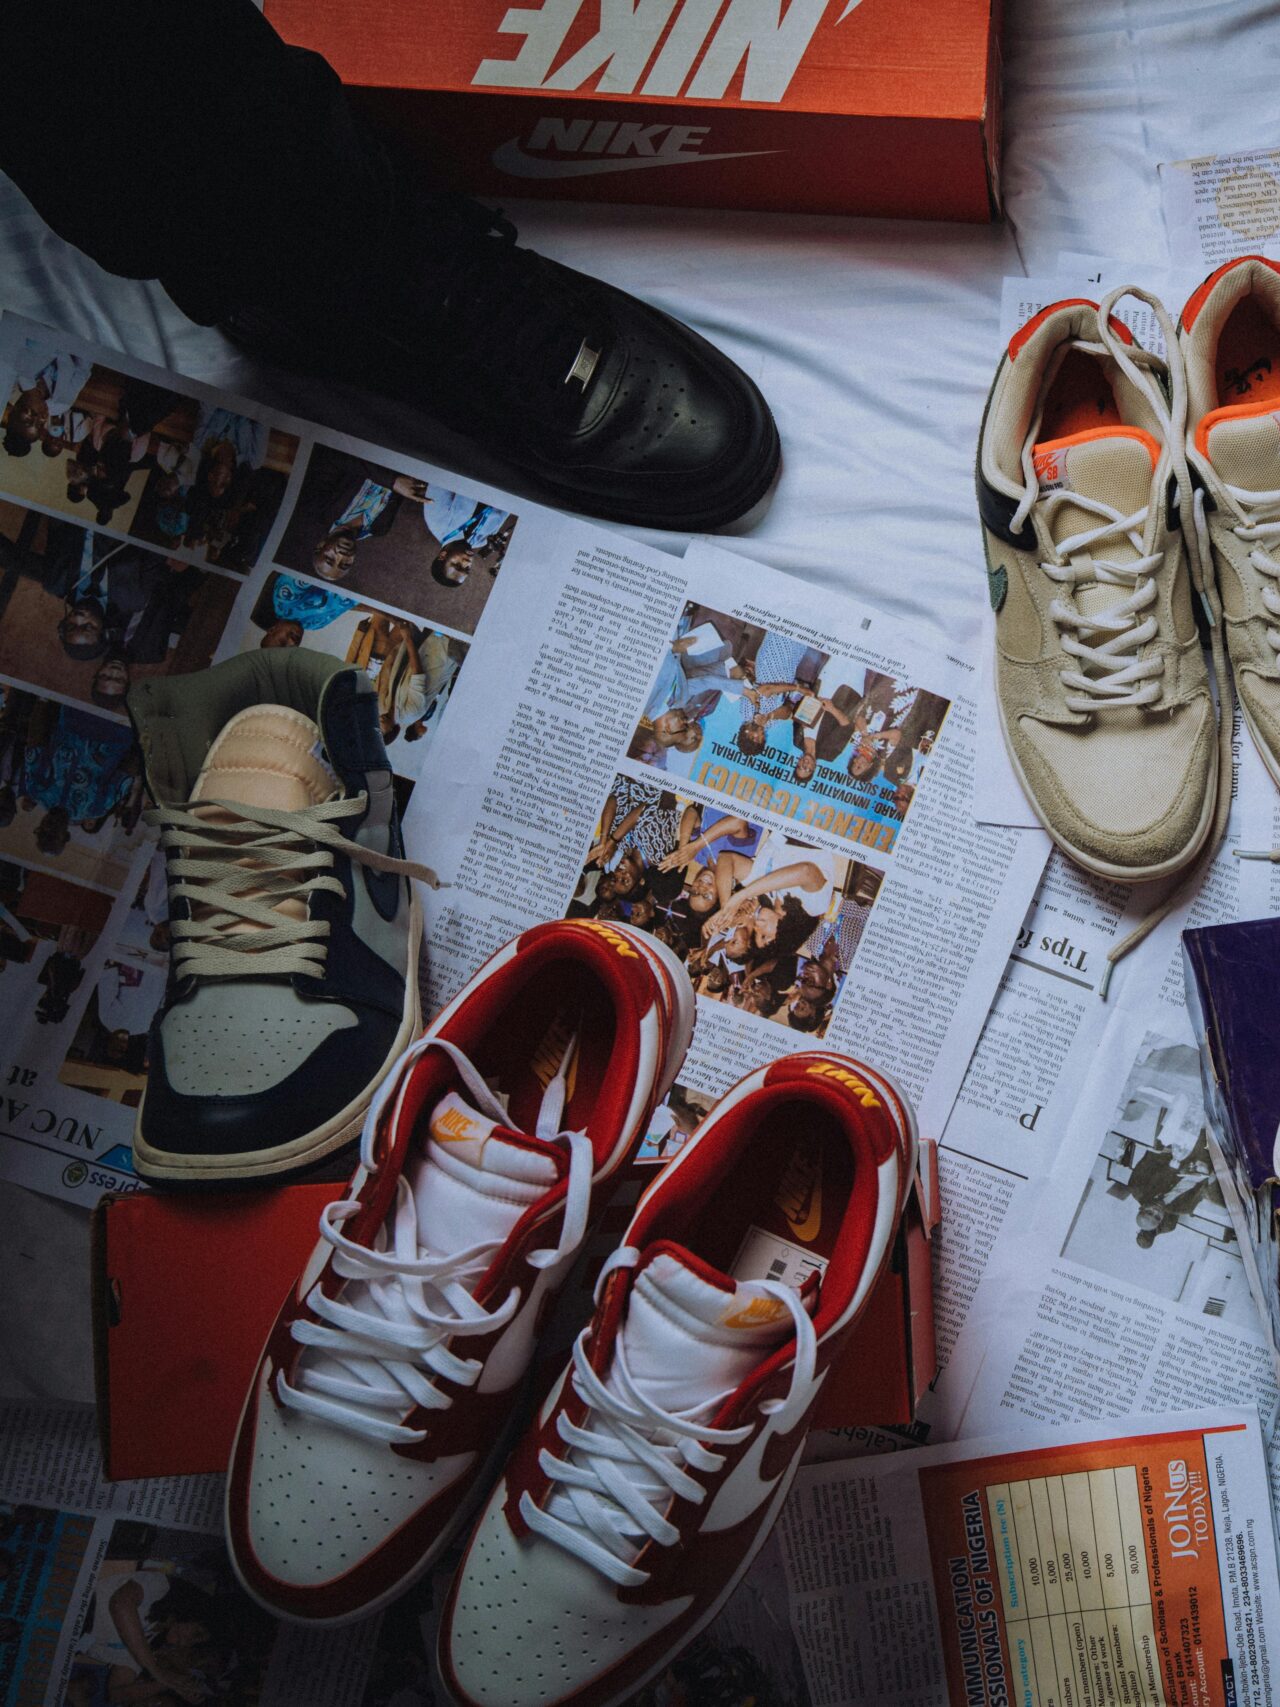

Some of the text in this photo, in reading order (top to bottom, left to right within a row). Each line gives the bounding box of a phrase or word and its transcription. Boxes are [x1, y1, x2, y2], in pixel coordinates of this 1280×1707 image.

[470, 0, 826, 109] NIKE
[526, 117, 712, 157] NIKE
[1043, 465, 1058, 480] SB
[622, 556, 660, 576] God-fearing
[661, 571, 688, 587] building
[744, 612, 766, 625] during
[850, 654, 890, 672] presentation
[1232, 741, 1242, 759] for
[679, 787, 714, 805] Innovation
[809, 778, 871, 810] INNOVATIVE
[716, 801, 750, 818] Disruptive
[752, 813, 783, 830] University
[785, 827, 802, 837] Caleb
[816, 837, 838, 849] during
[840, 847, 866, 861] Students
[1044, 904, 1116, 936] Reduce Sitting and
[1041, 937, 1087, 972] Tips
[7, 1066, 37, 1087] at
[30, 1109, 103, 1149] NUC
[438, 1107, 471, 1135] NIKE
[1164, 1484, 1198, 1557] JOIN
[1189, 1472, 1208, 1545] TODAY!!!
[960, 1491, 988, 1573] NIGERIA
[1003, 1538, 1018, 1608] Subscription
[1029, 1558, 1040, 1586] 10,000
[1047, 1560, 1057, 1584] 5,000
[1062, 1553, 1073, 1582] 25,000
[1081, 1551, 1091, 1579] 10,000
[1104, 1554, 1114, 1577] 5,000
[1128, 1545, 1139, 1574] 30,000
[1141, 1467, 1170, 1657] of Scholars & Professionals of Nigeria
[975, 1576, 993, 1605] OF
[1255, 1594, 1263, 1624] Website:
[1098, 1637, 1108, 1669] of work
[1180, 1618, 1195, 1676] 0141407323
[1189, 1587, 1207, 1693] Account: 0141439012
[1018, 1639, 1029, 1686] category
[1073, 1623, 1089, 1694] members (open)
[1090, 1636, 1105, 1706] Members: Other
[1113, 1625, 1131, 1704] Student Members:
[1143, 1635, 1156, 1690] Membership
[1174, 1652, 1189, 1706] Trust Bank
